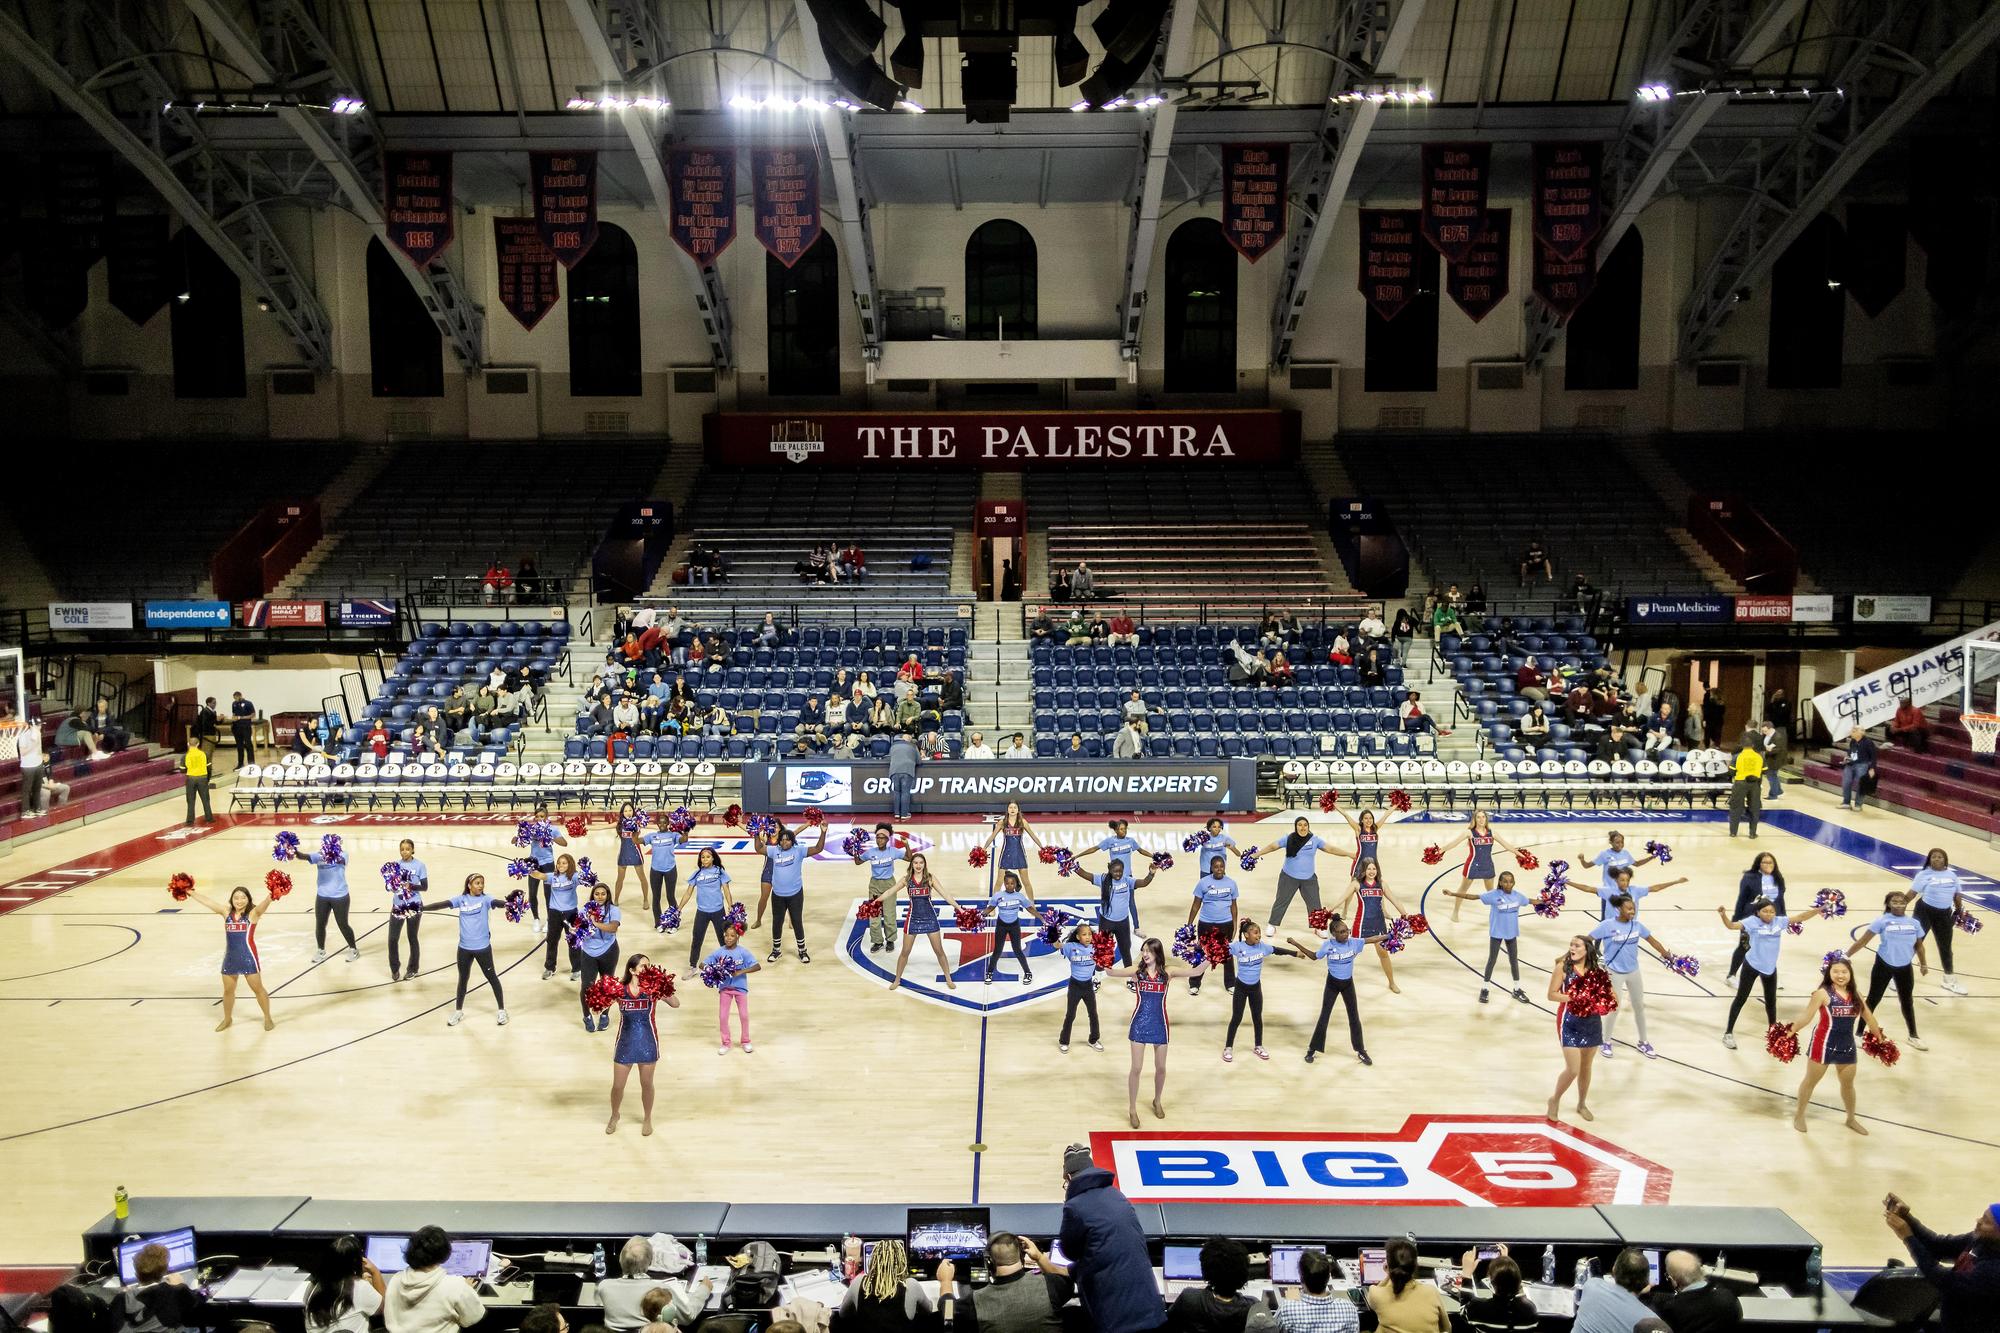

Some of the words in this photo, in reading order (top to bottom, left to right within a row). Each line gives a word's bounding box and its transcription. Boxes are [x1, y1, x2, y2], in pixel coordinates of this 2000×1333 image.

[1440, 225, 1469, 241] 1975
[406, 232, 434, 247] 1955
[858, 426, 956, 459] THE
[982, 424, 1235, 457] PALESTRA
[1651, 603, 1674, 612] Penn
[1676, 602, 1721, 613] Medicine
[1736, 607, 1748, 617] GO
[1749, 606, 1791, 617] QUAKERS!
[148, 609, 215, 619] Independence
[64, 616, 89, 624] COLE
[1836, 679, 1883, 705] THE
[290, 755, 297, 763] P
[1695, 752, 1702, 760] P
[248, 767, 255, 775] P
[341, 766, 348, 774] P
[388, 766, 395, 774] P
[434, 766, 441, 774] P
[481, 764, 488, 772] P
[527, 765, 534, 773] P
[573, 764, 580, 772] P
[624, 764, 631, 772] P
[1291, 763, 1298, 771] P
[1338, 763, 1345, 771] P
[1384, 763, 1391, 771] P
[1431, 763, 1438, 771] P
[1525, 763, 1532, 771] P
[1573, 763, 1580, 771] P
[1620, 763, 1627, 771] P
[1667, 763, 1674, 771] P
[1714, 763, 1721, 771] P
[863, 775, 934, 794] GRUP
[940, 776, 1125, 795] TRANSPORTATION
[1127, 775, 1218, 793] EXPERTS
[357, 813, 431, 822] Penn
[432, 813, 562, 822] Medicie
[1551, 811, 1686, 819] Medicine
[1136, 1150, 1409, 1188] BIG
[1471, 1152, 1578, 1190] 5
